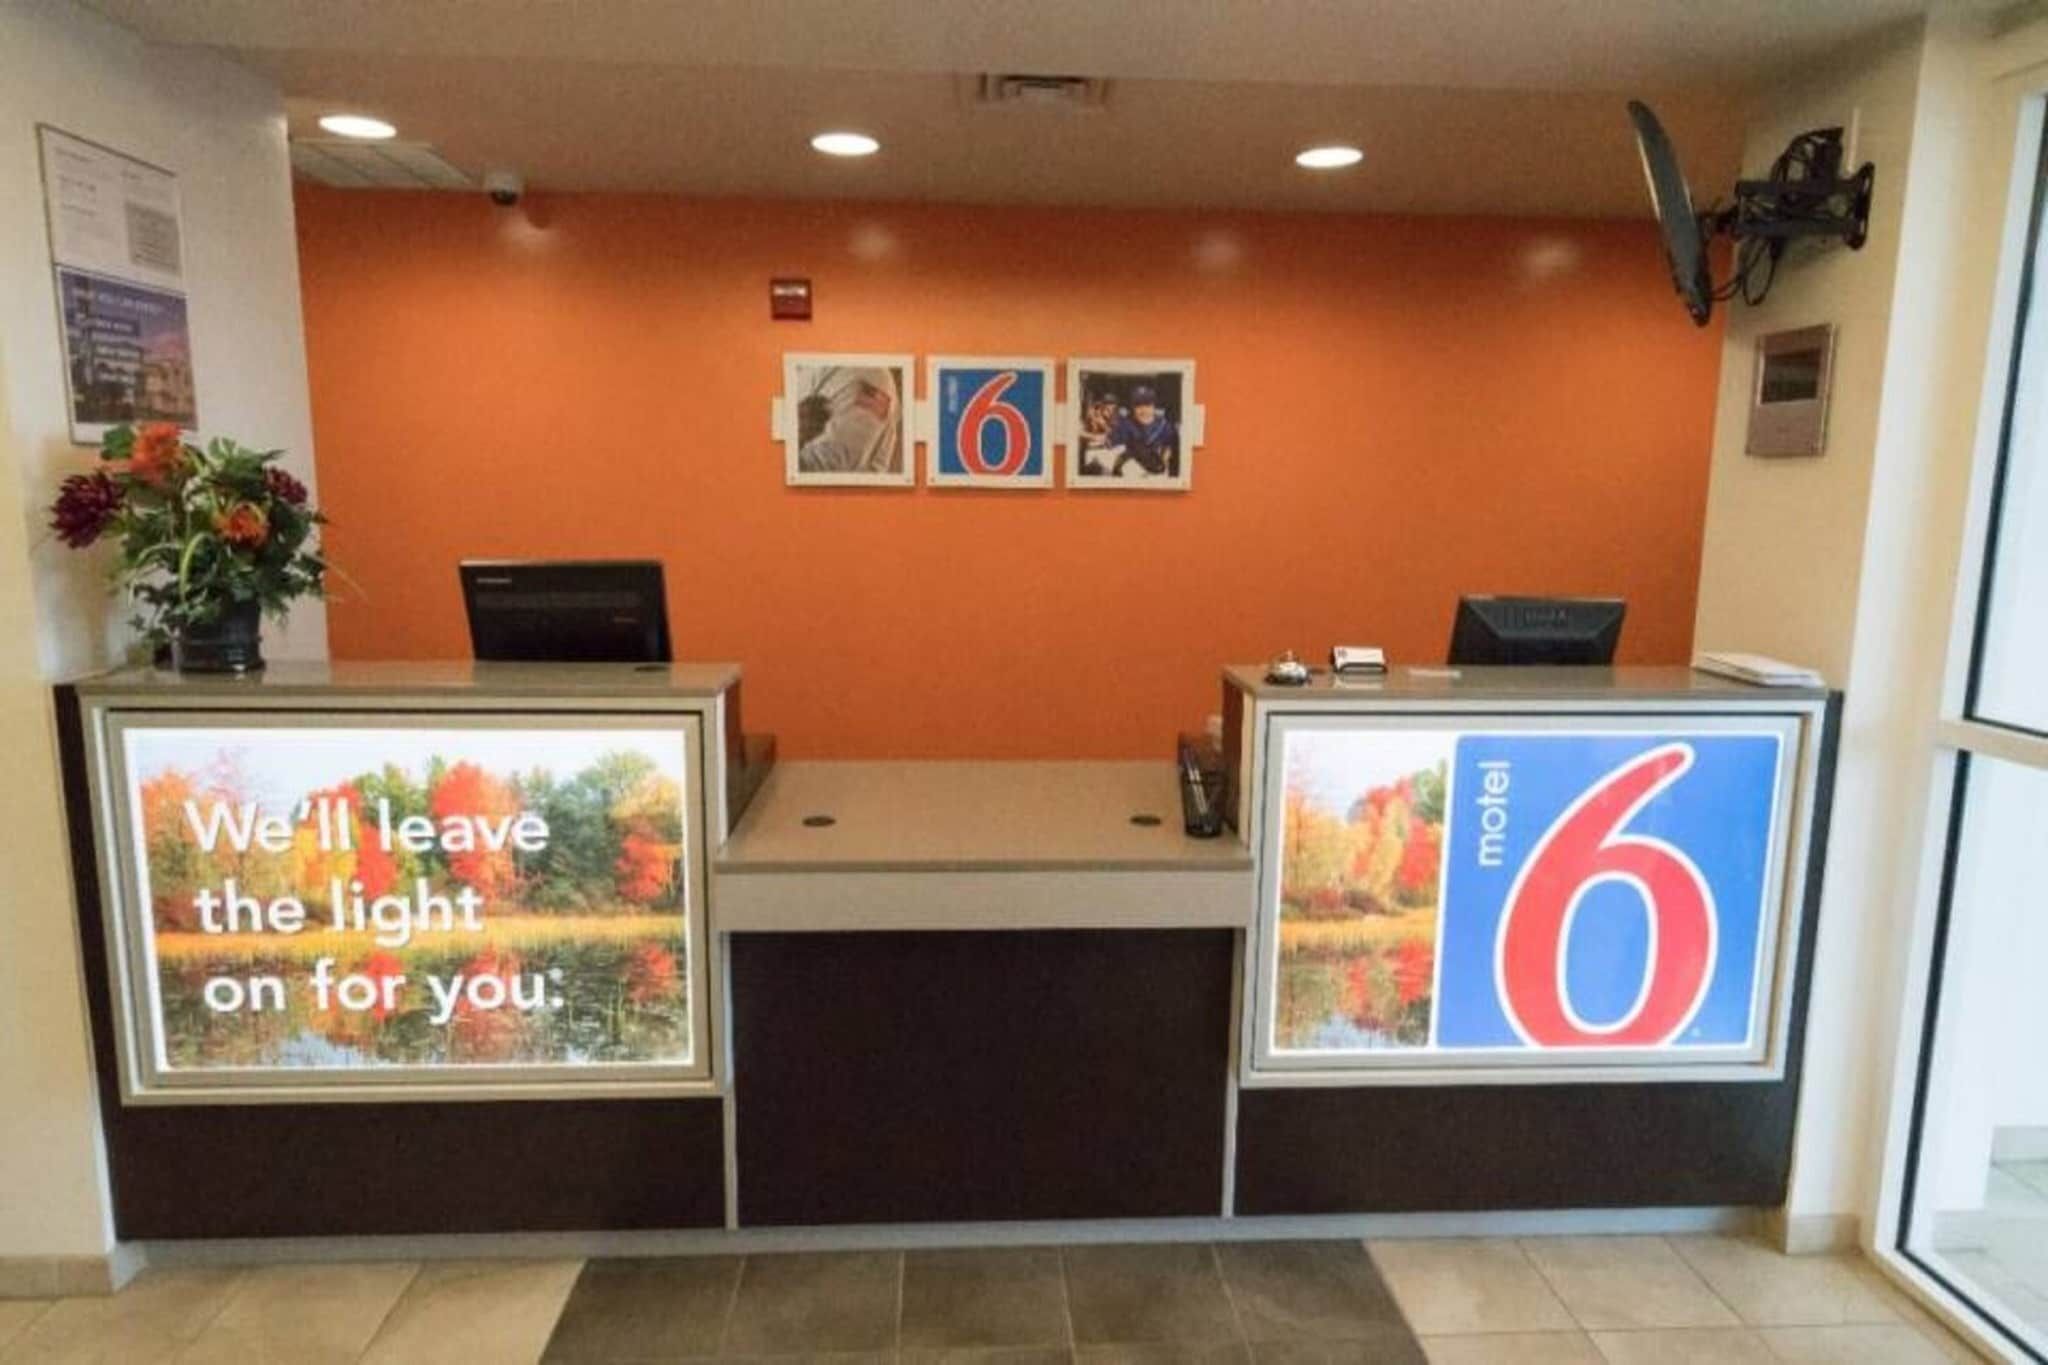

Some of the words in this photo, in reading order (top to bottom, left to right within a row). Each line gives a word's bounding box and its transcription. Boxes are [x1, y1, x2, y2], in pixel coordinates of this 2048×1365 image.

[956, 371, 1031, 477] 6
[185, 798, 352, 854] We'll
[380, 799, 550, 853] leave
[193, 878, 306, 933] the
[331, 878, 484, 947] light
[1477, 759, 1511, 867] motel
[1494, 740, 1719, 1048] 6
[204, 975, 286, 1012] on
[309, 959, 407, 1010] for
